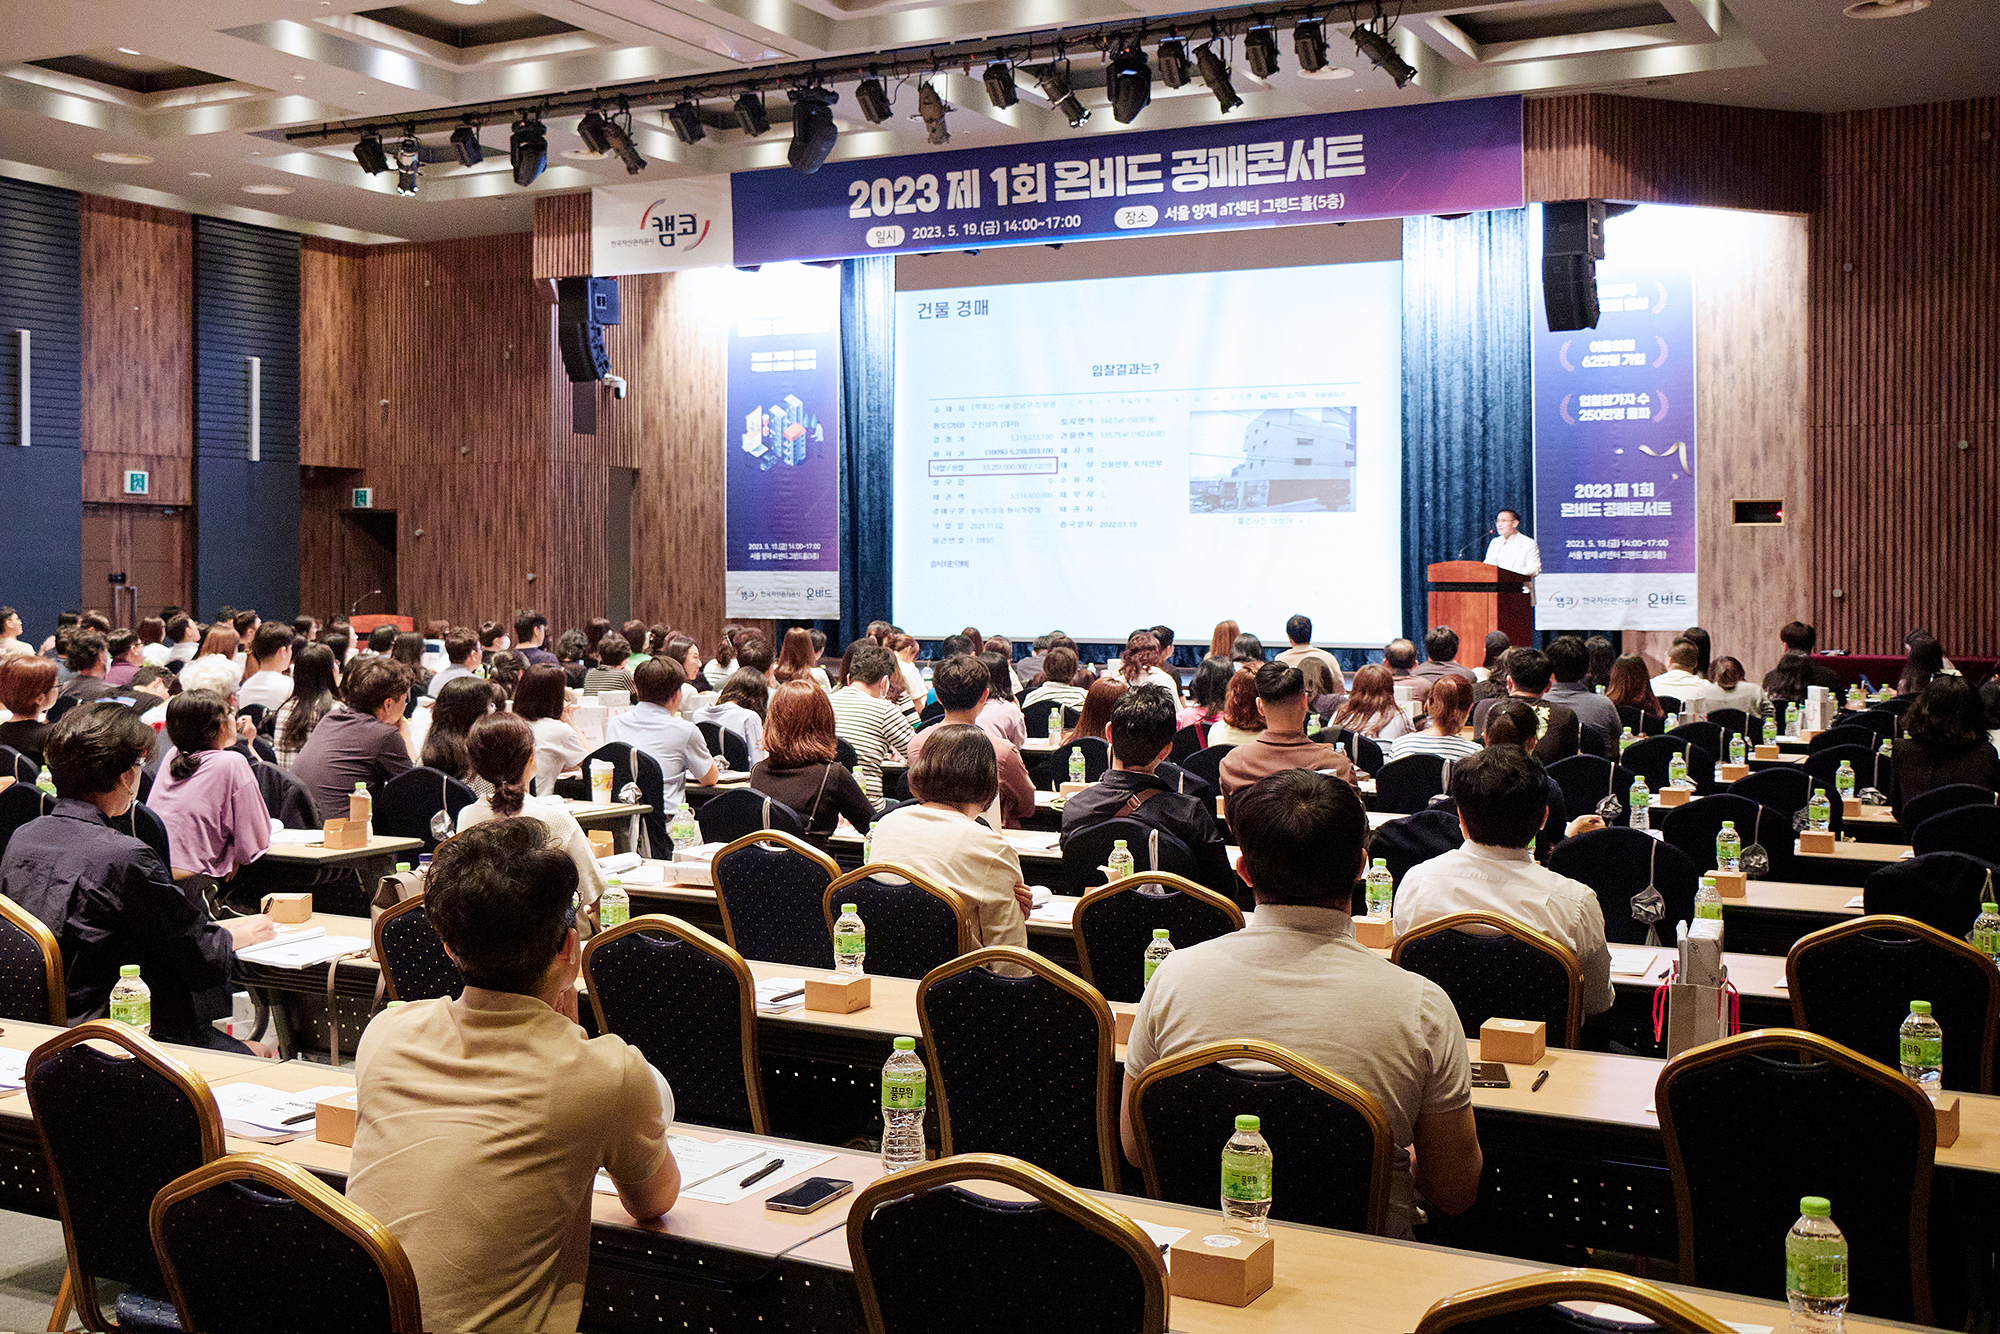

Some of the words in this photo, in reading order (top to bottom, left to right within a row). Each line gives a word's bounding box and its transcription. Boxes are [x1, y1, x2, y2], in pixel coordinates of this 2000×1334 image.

[848, 174, 939, 218] 2023
[946, 169, 981, 209] 제
[990, 162, 1047, 206] 1회
[1055, 153, 1163, 202] 온비드
[1171, 134, 1366, 193] 공매콘서트
[1164, 206, 1189, 220] 서울
[1192, 203, 1217, 219] 양재
[1219, 200, 1259, 217] aT센터
[1262, 193, 1345, 215] 그랜드홀(5층)
[1125, 210, 1148, 224] 장소
[652, 213, 698, 247] 캠코
[912, 225, 946, 241] 2023.
[949, 224, 960, 238] 5.
[964, 220, 1000, 237] 19.(금)
[1003, 215, 1081, 233] 14:00~17:00
[875, 231, 897, 244] 일시
[917, 301, 949, 320] 건물
[956, 299, 990, 317] 경매
[1582, 353, 1620, 367] 62만명
[1622, 353, 1646, 365] 가입
[1092, 362, 1160, 377] 입찰결과는?
[1579, 393, 1636, 407] 입찰참가자
[1637, 392, 1650, 405] 수
[1579, 408, 1625, 421] 250만명
[1574, 484, 1613, 498] 2023
[1613, 483, 1629, 498] 제
[1631, 482, 1655, 498] 1회
[1560, 502, 1602, 518] 온비드
[1603, 501, 1672, 518] 공매콘서트
[748, 543, 764, 551] 2023.
[1565, 540, 1587, 548] 2023.
[1588, 540, 1596, 548] 5.
[806, 587, 833, 600] 온비드
[1648, 592, 1687, 608] 온비드
[890, 1086, 914, 1102] 풀무원
